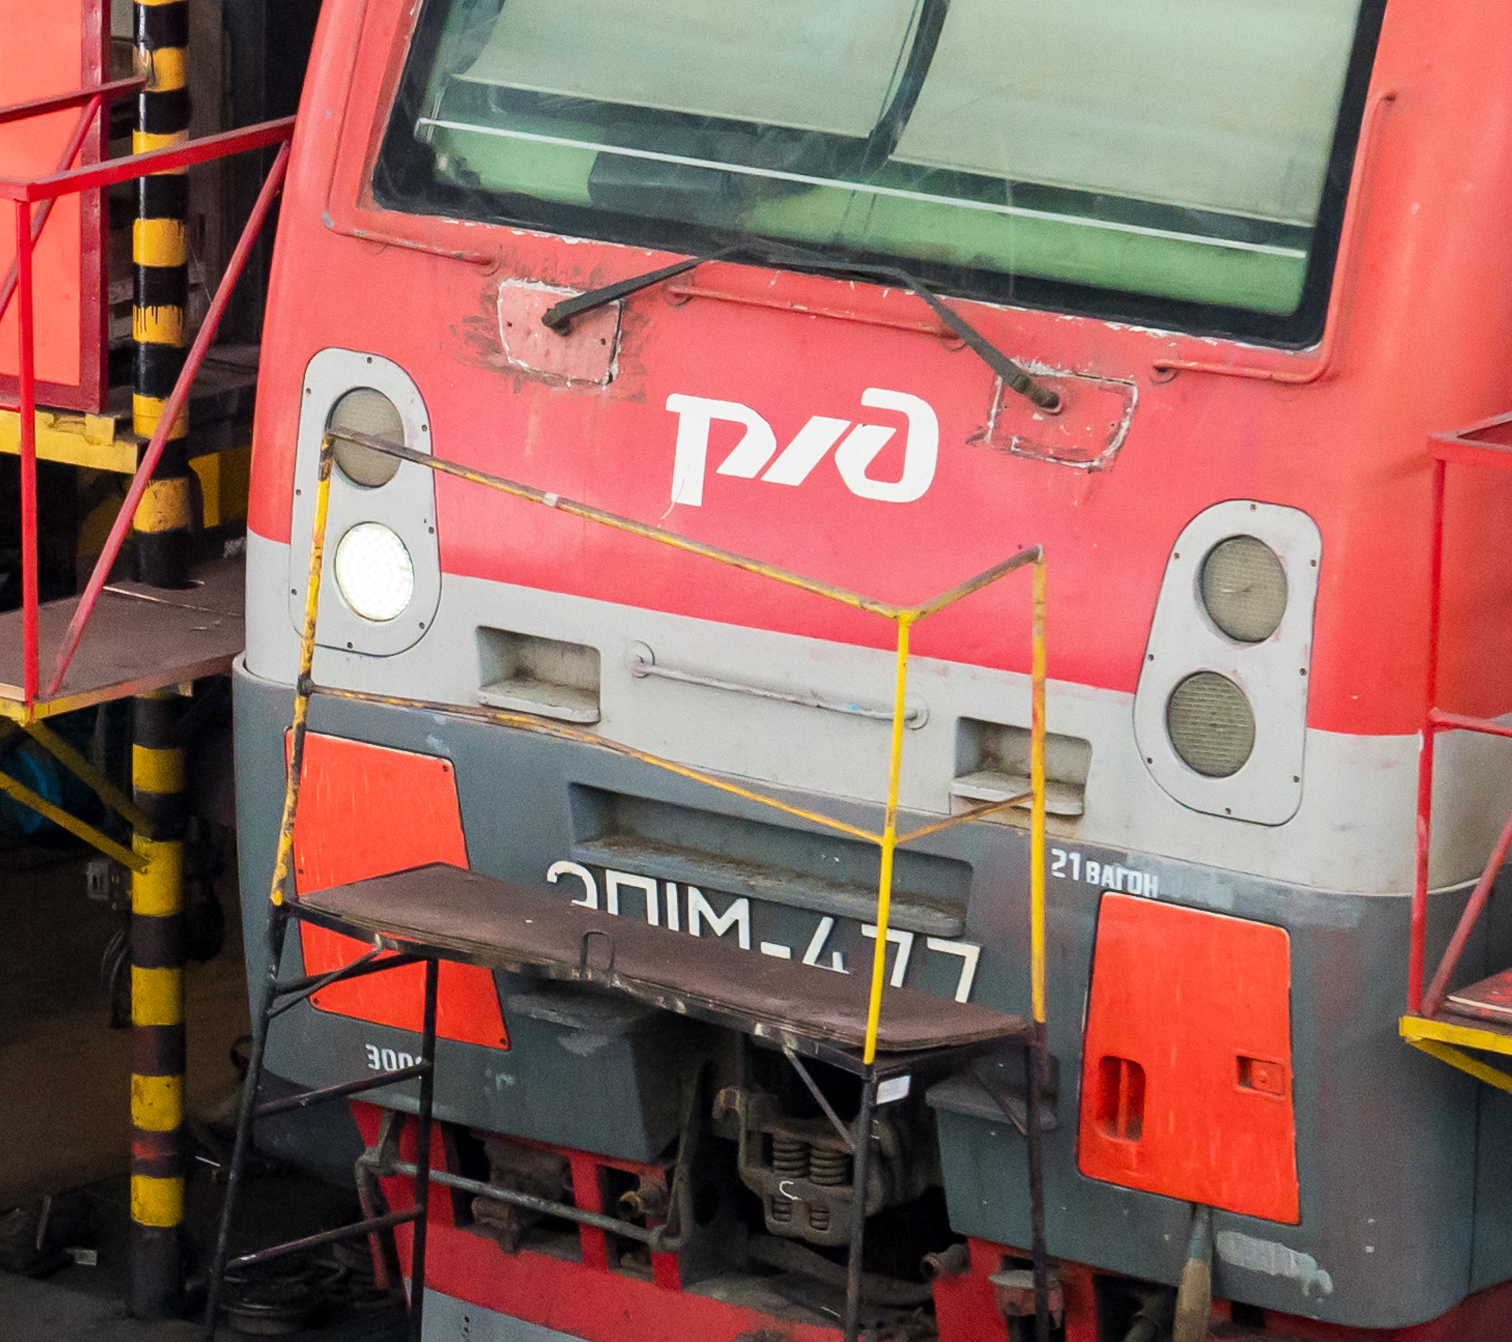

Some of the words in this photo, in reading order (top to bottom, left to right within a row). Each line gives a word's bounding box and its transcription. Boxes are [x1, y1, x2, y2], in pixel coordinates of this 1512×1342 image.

[665, 387, 939, 507] РЖД
[1051, 848, 1081, 881] 21
[1085, 860, 1159, 898] ВАГОН
